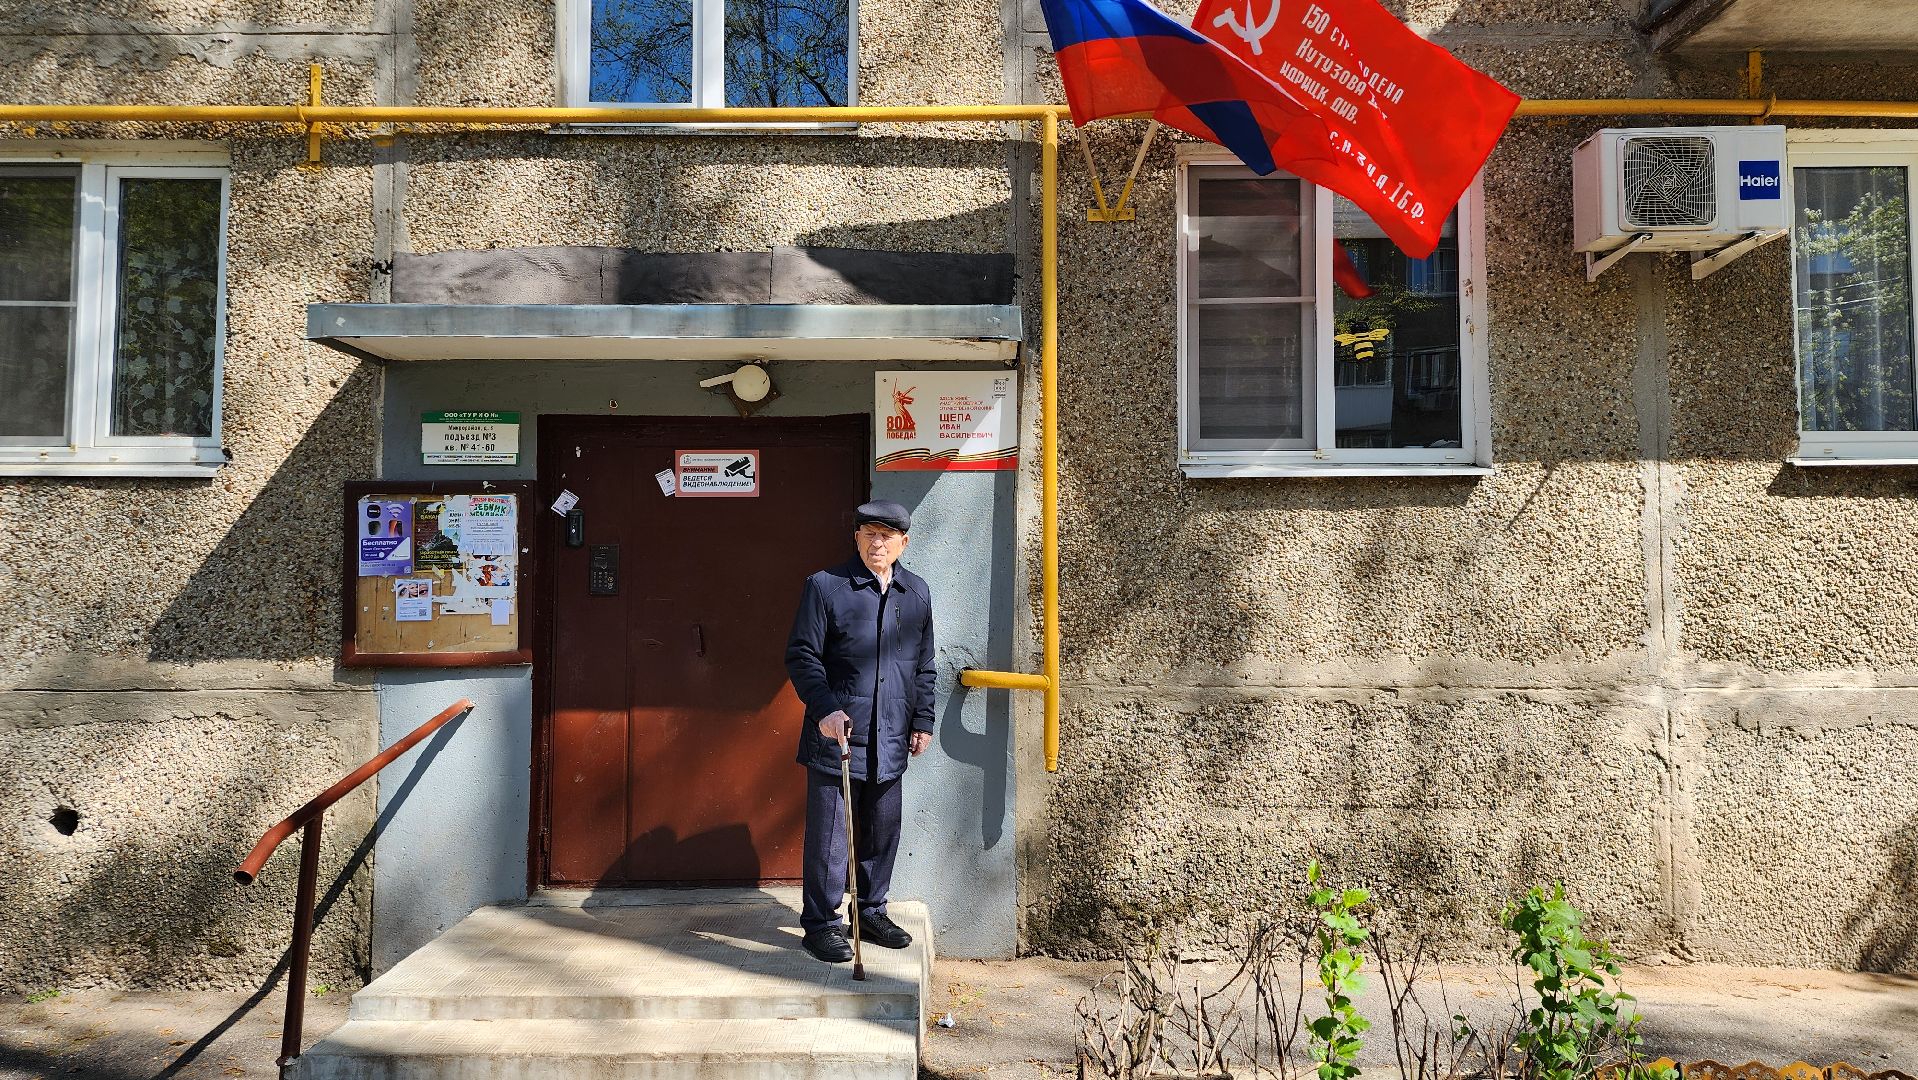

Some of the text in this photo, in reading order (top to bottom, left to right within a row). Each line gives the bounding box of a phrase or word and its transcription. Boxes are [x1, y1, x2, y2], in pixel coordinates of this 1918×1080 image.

[1301, 3, 1331, 35] 150
[1740, 174, 1779, 187] Haier
[939, 413, 972, 423] ЩЕПА
[444, 433, 481, 442] подъезд
[886, 431, 916, 440] ПОБЕДА!
